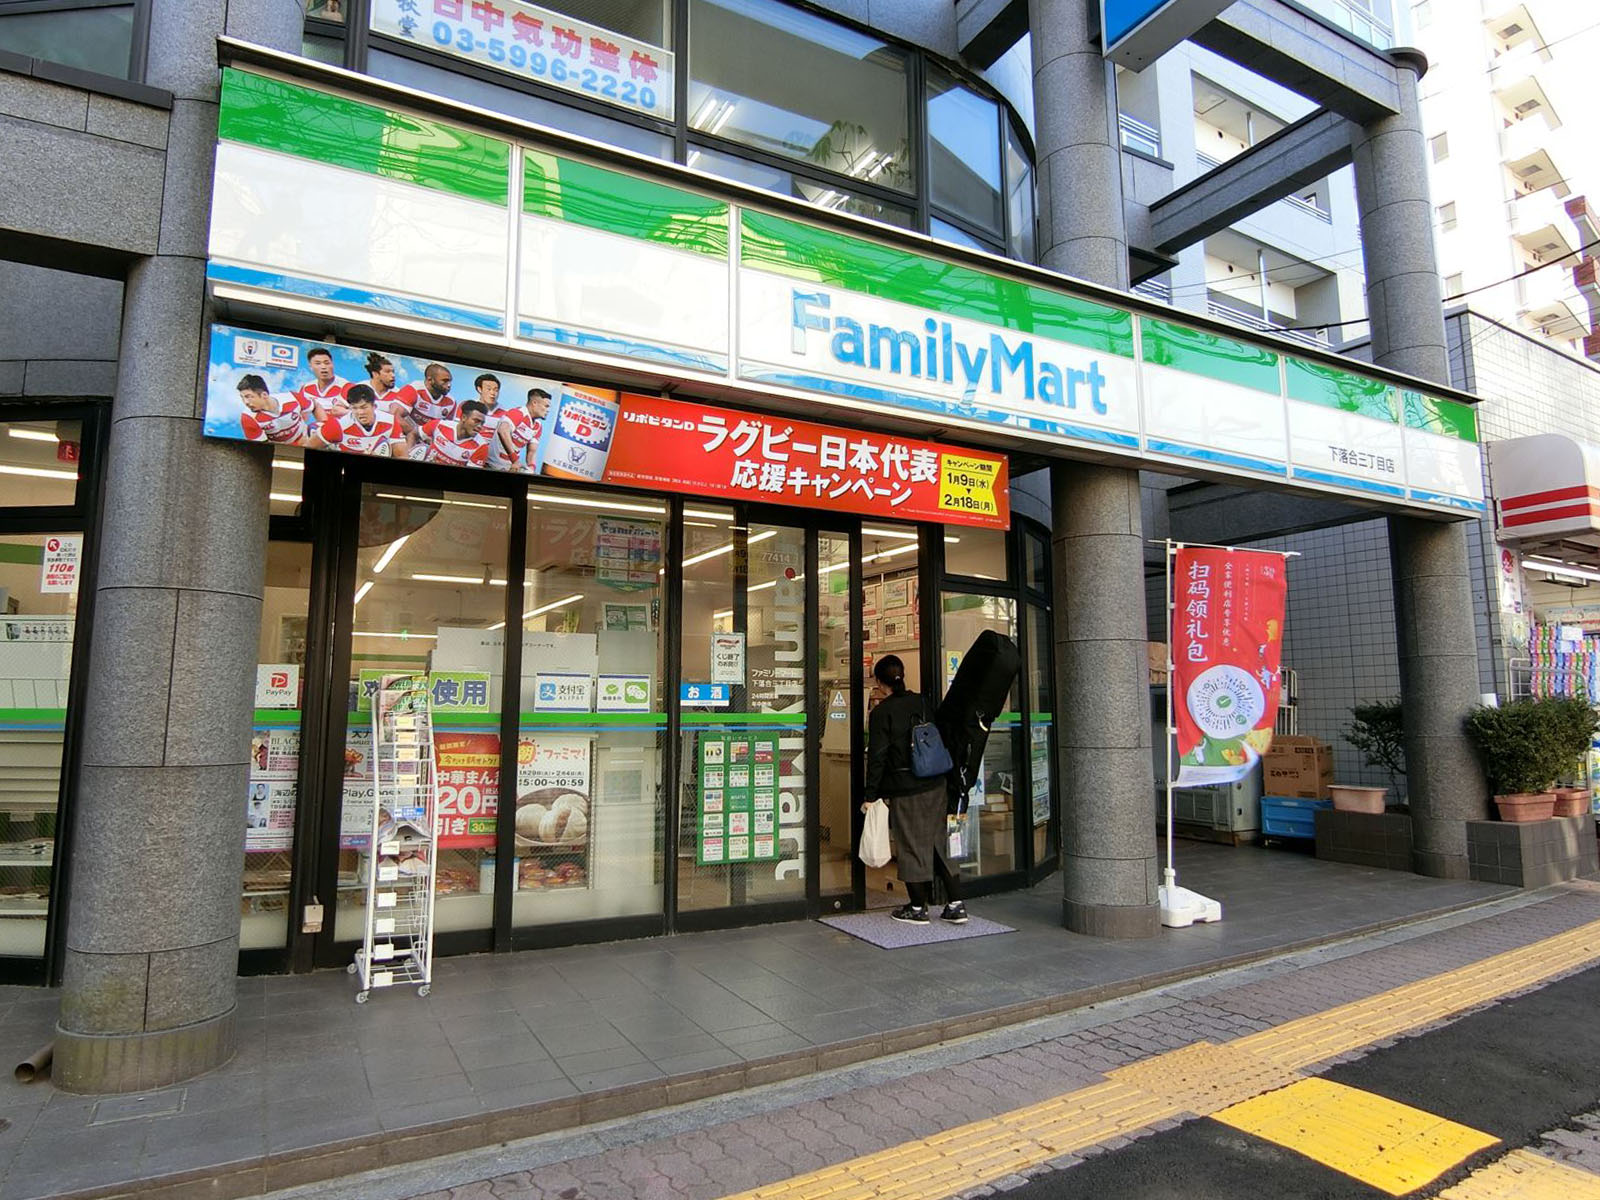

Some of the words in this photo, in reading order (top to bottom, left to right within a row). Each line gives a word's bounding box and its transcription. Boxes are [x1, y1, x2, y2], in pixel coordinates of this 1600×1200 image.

[432, 21, 656, 109] 03-5996-2220
[791, 287, 1107, 415] FamilyMart
[623, 412, 695, 431] リポビタンD
[698, 415, 938, 485] ラグビー日本代表
[1328, 445, 1395, 473] 下落合三丁目店
[947, 459, 992, 472] キャンペーン期間
[730, 460, 912, 506] 応援キャンペーン
[948, 472, 989, 489] 1月9日(水)
[944, 494, 993, 511] 2月18日(月)
[1186, 561, 1210, 662] 扫码领礼包
[432, 679, 488, 706] 使用
[559, 684, 585, 695] 支付宝
[687, 686, 722, 700] お酒
